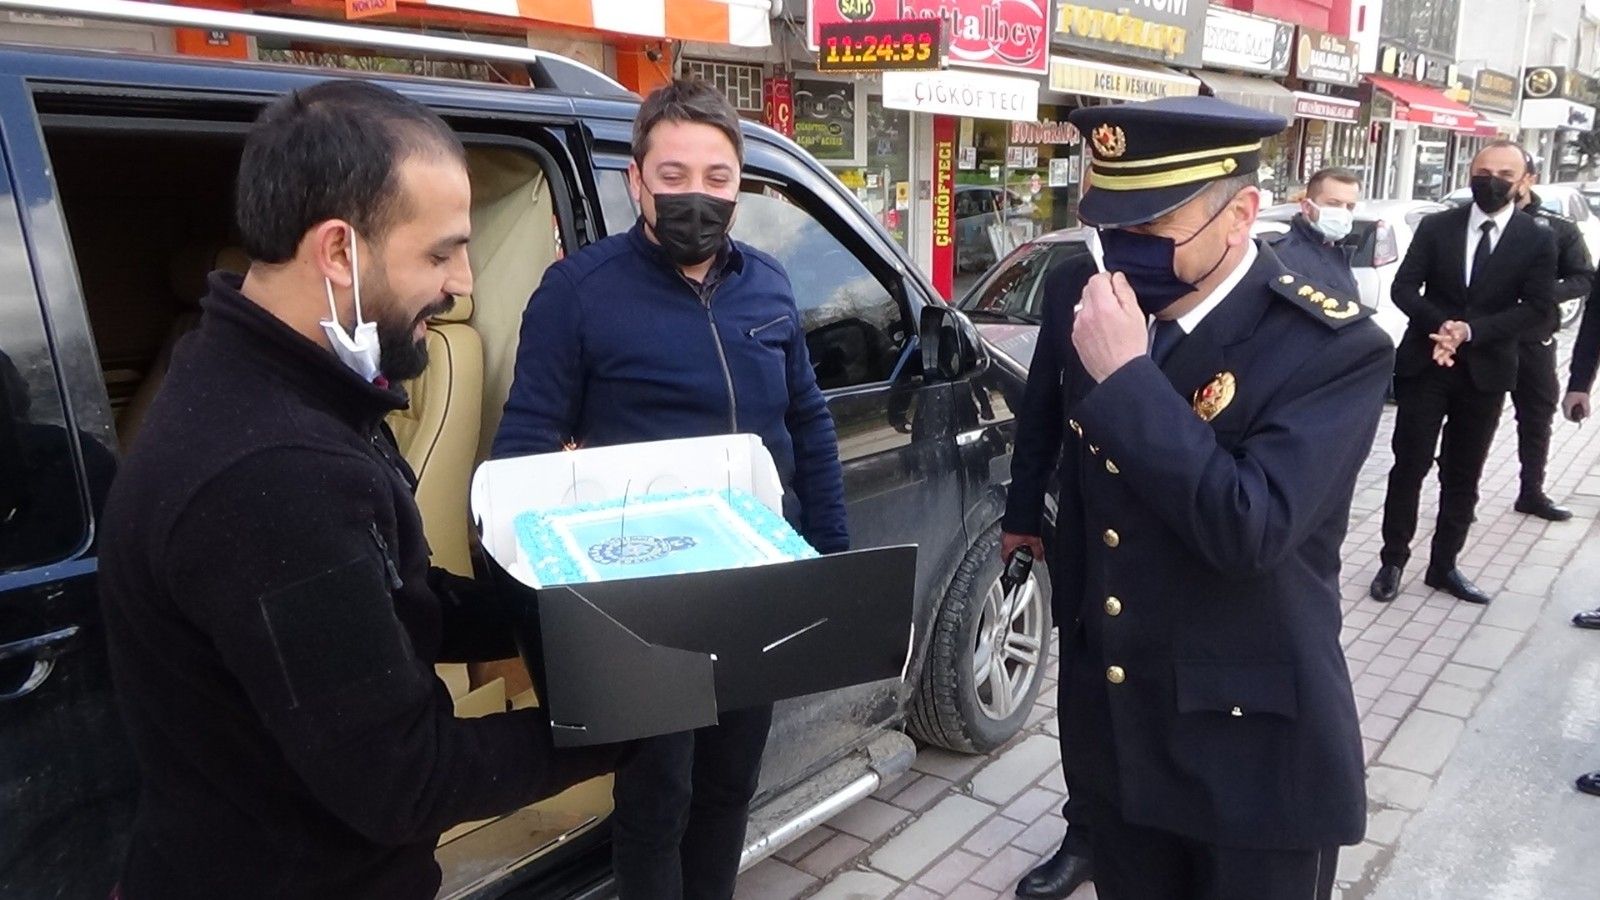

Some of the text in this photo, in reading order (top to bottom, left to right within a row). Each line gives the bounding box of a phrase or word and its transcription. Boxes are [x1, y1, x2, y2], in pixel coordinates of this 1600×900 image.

[827, 33, 932, 62] 11:24:33
[1094, 72, 1121, 92] ACELE
[934, 141, 952, 246] ÇİĞKÖFTECİ
